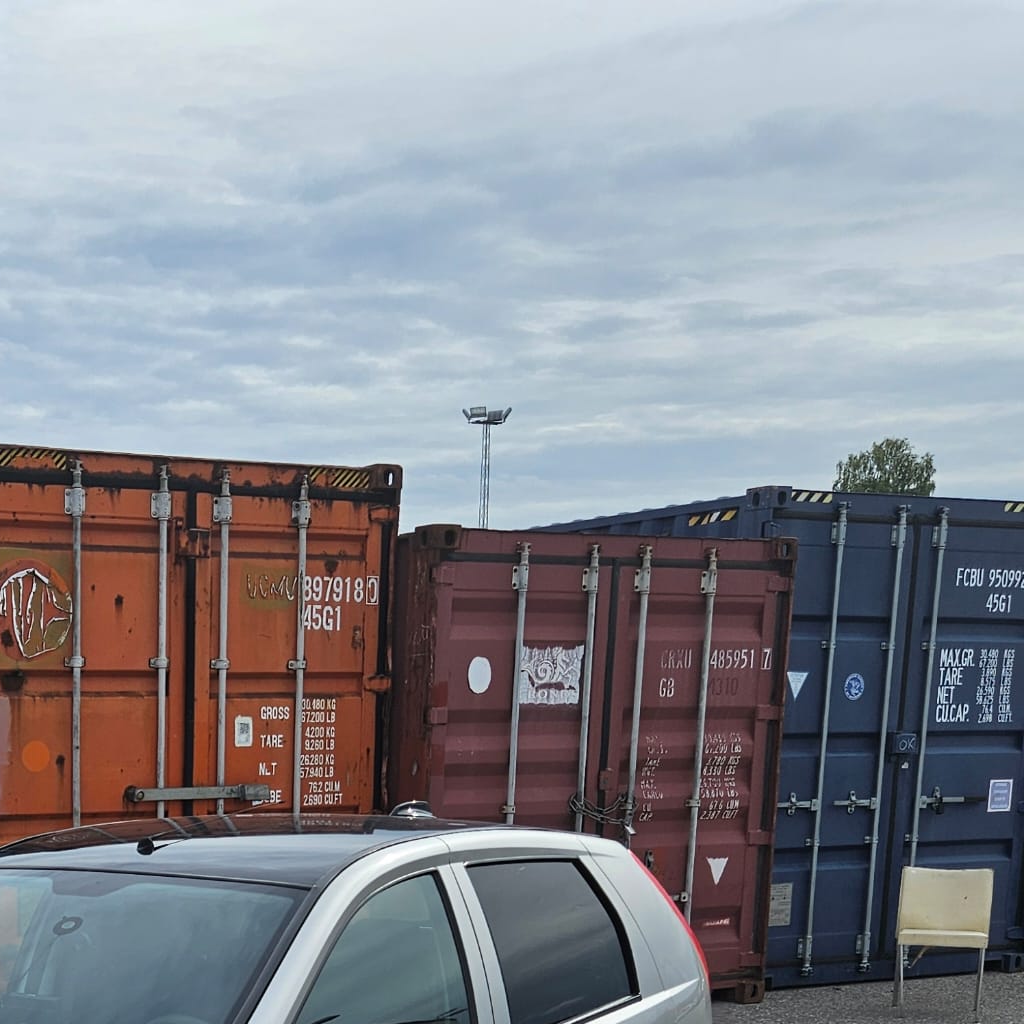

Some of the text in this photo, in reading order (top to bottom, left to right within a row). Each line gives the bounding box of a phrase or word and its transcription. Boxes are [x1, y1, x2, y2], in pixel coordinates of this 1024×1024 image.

[955, 567, 985, 587] FCBU
[303, 575, 364, 603] 897918
[985, 593, 1012, 613] 45G1
[303, 604, 341, 631] 45G1
[710, 648, 755, 669] 485951
[762, 648, 771, 669] 7
[939, 667, 964, 686] TARE
[659, 677, 675, 698] GB
[936, 686, 955, 705] NET
[326, 698, 336, 710] KG
[260, 706, 290, 720] GROSS
[326, 711, 336, 723] LB
[325, 726, 336, 738] KG
[260, 734, 284, 748] TARE
[325, 739, 335, 750] LB
[899, 737, 915, 751] OK
[325, 754, 335, 765] KG
[324, 766, 334, 778] LB
[252, 789, 283, 806] BE
